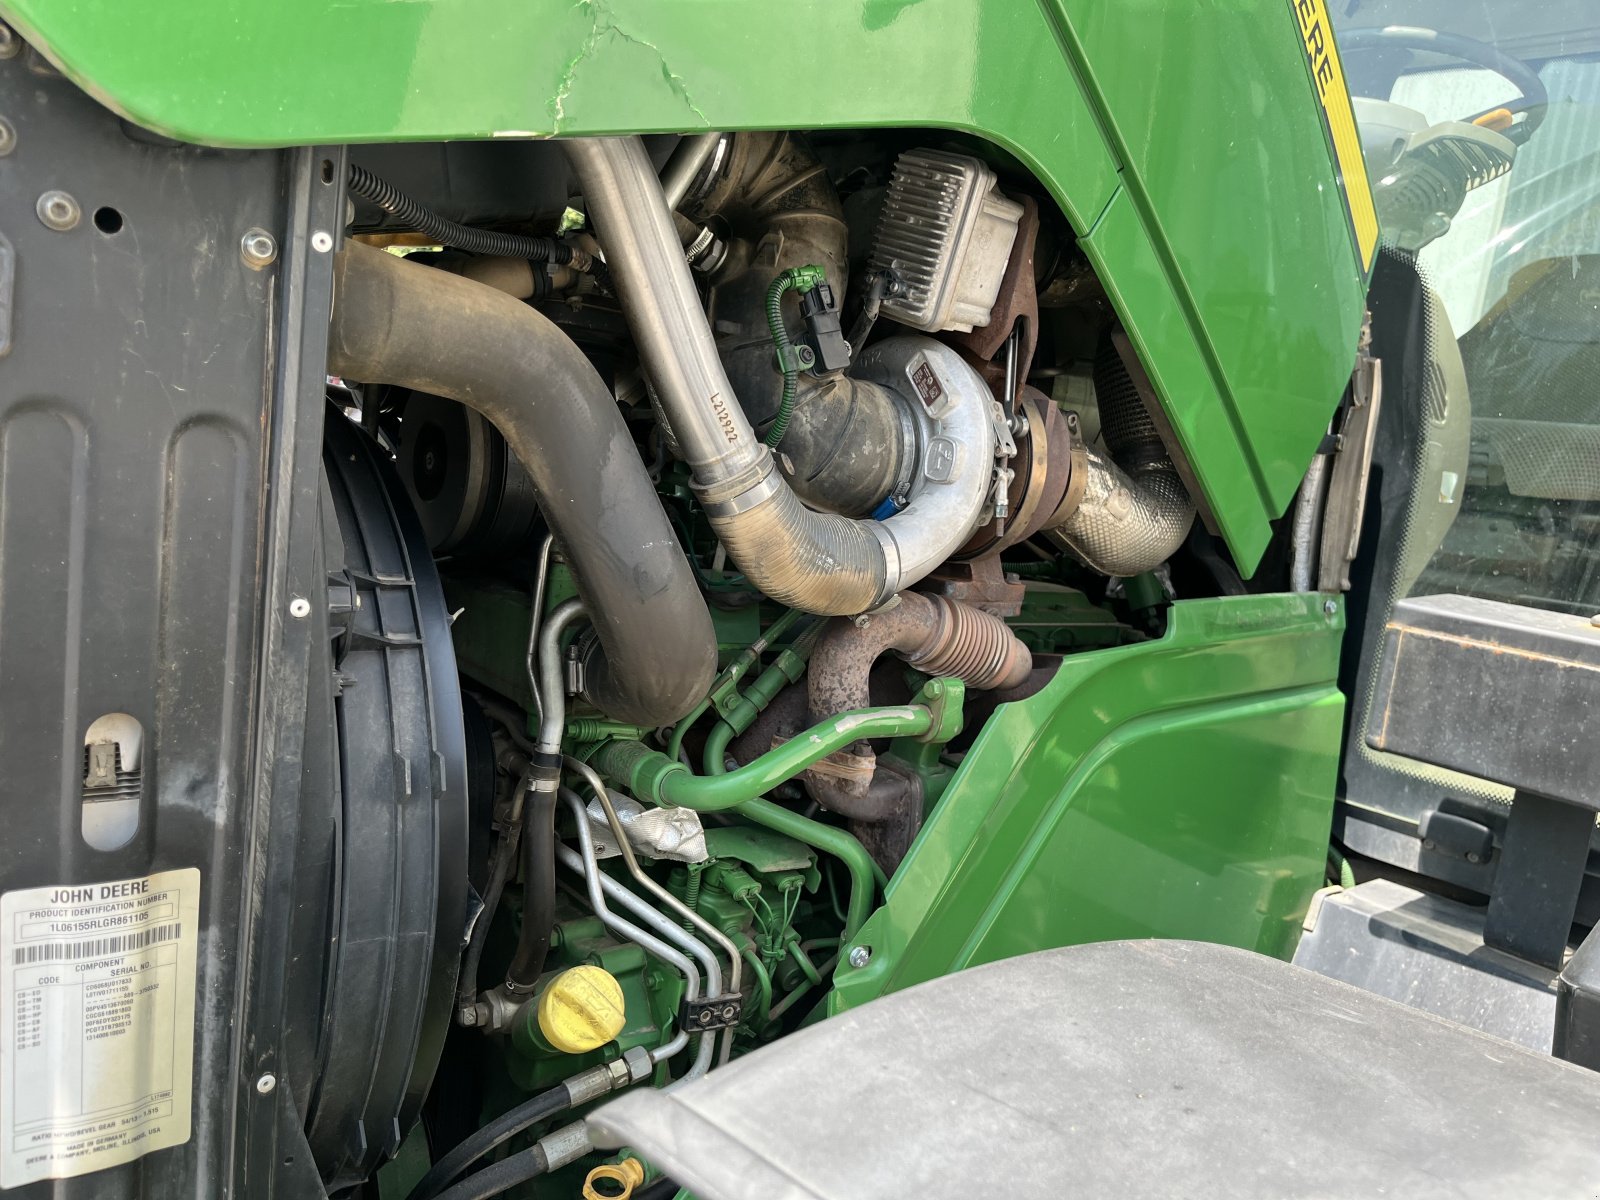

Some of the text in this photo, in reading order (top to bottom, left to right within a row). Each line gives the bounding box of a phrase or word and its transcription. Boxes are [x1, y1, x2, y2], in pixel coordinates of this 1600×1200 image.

[710, 392, 738, 443] L212922
[50, 880, 150, 904] JOHN DEERE
[30, 893, 168, 920] PRODUCT IDENTIFICATION NUMBER
[50, 912, 148, 932] 1L06155RLGR861105
[76, 958, 125, 972] COMPONENT
[110, 962, 152, 976] SERIAL NO.
[38, 976, 60, 984] CODE
[32, 1133, 52, 1142] RATIO
[98, 1122, 116, 1130] GEAR
[96, 1133, 127, 1144] GERMANY
[26, 1155, 47, 1164] DEERE
